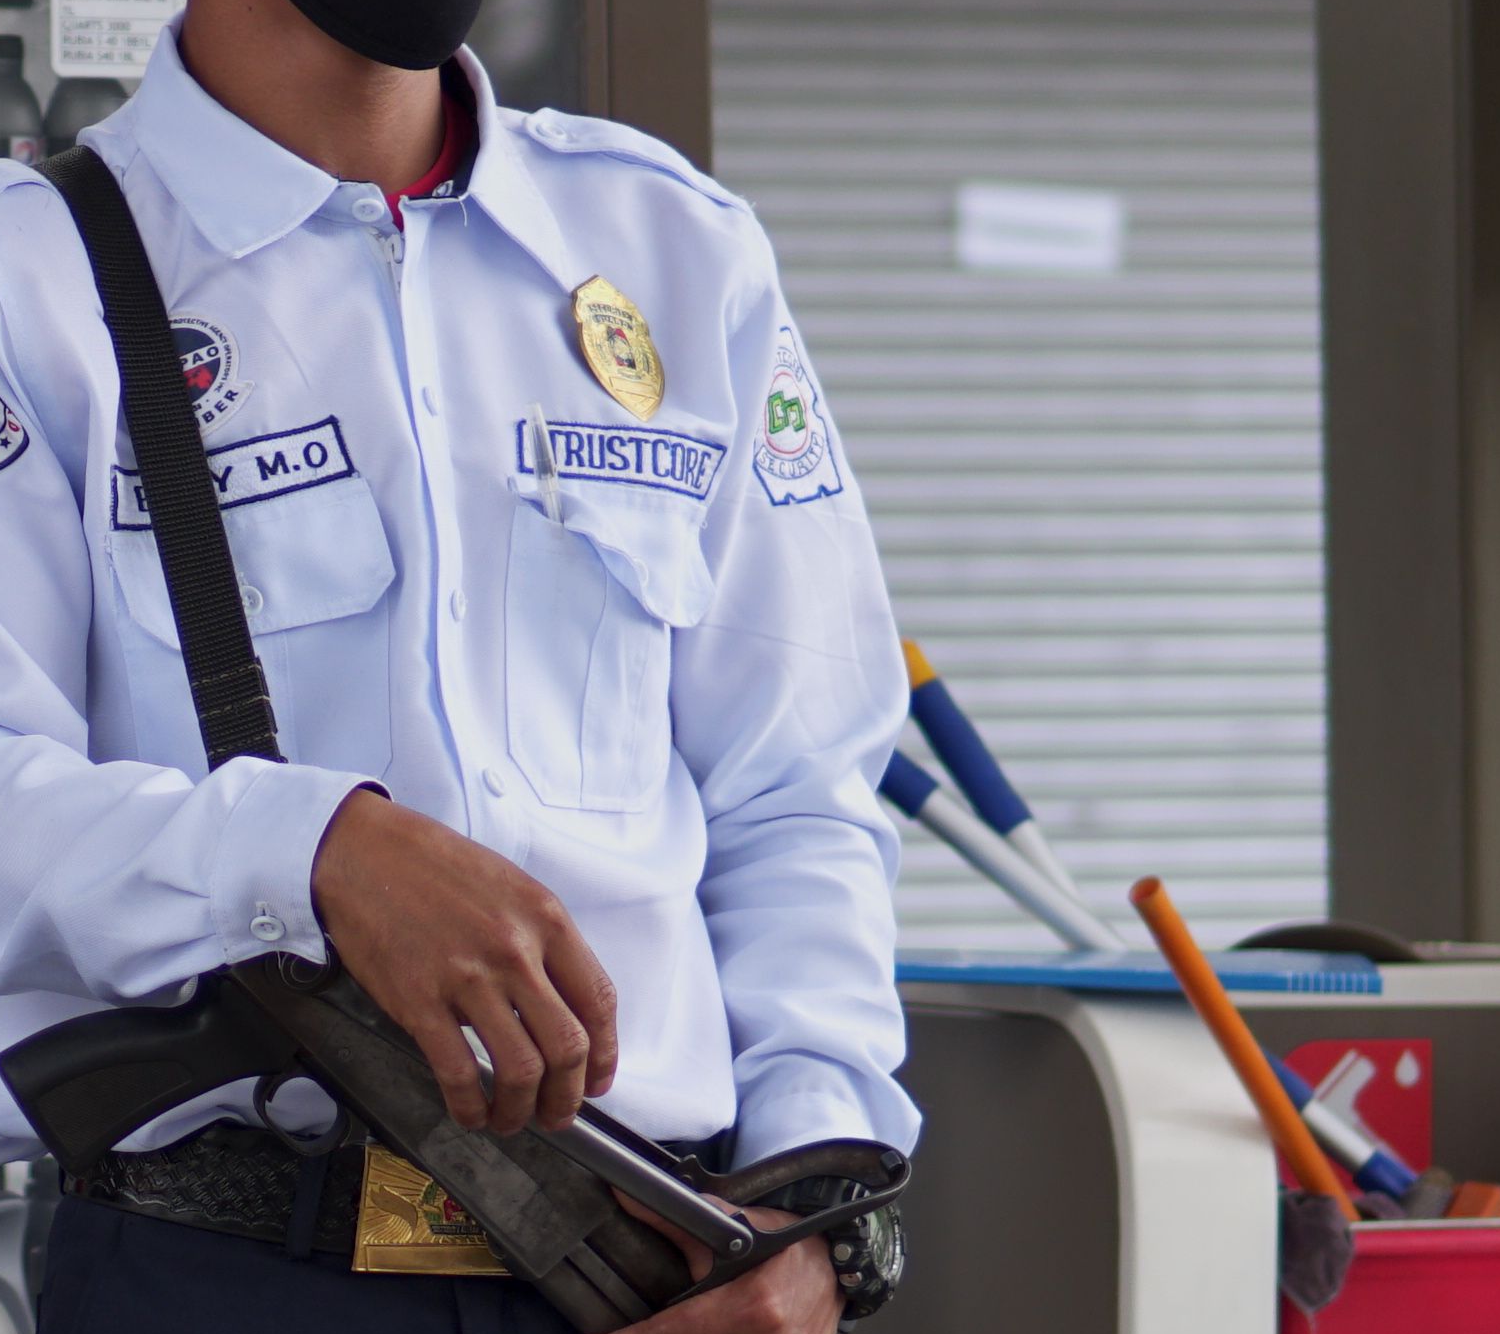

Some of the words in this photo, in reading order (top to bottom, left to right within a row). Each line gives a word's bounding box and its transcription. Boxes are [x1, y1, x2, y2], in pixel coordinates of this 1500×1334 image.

[255, 441, 328, 481] M.O
[550, 429, 712, 490] TRUSTCORE
[759, 437, 824, 477] SECURITY
